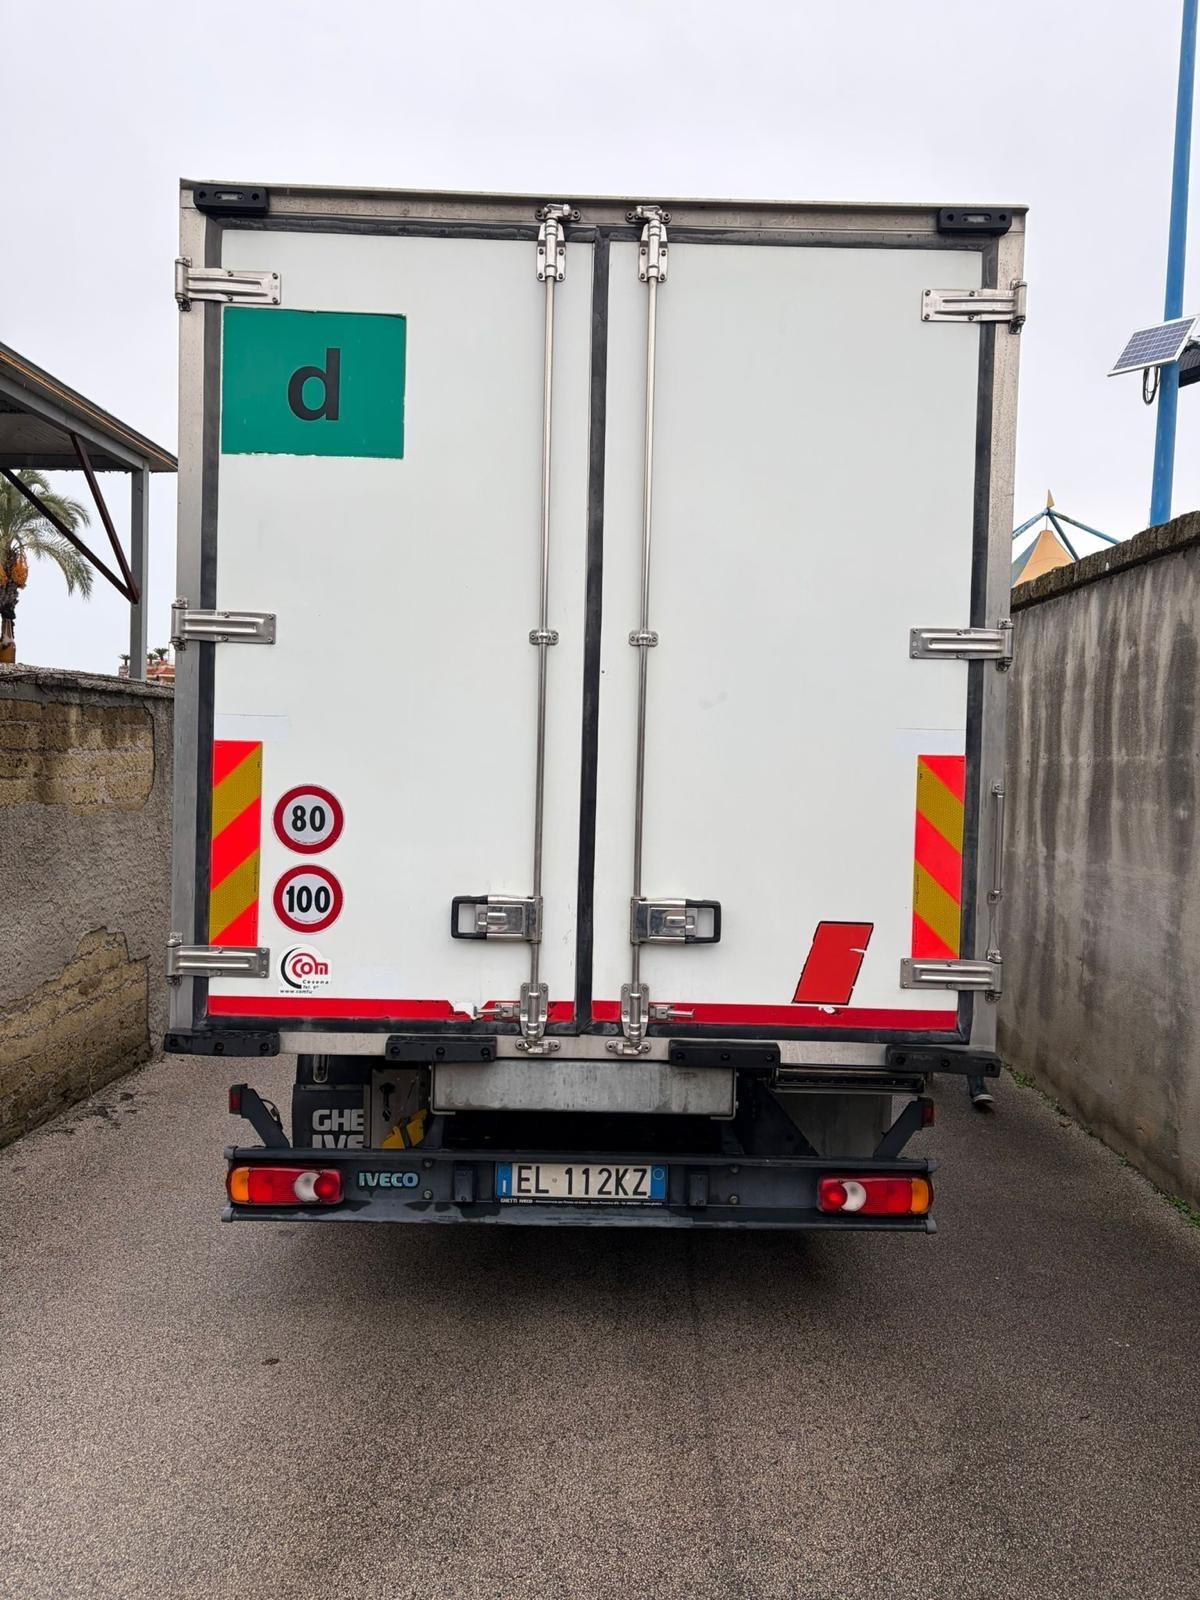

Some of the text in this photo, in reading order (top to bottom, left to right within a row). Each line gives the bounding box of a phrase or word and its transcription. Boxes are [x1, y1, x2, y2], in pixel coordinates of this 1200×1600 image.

[287, 347, 341, 421] d
[291, 804, 326, 832] 80
[286, 885, 331, 914] 100
[358, 1172, 419, 1188] IVECO
[517, 1165, 550, 1194] EL
[564, 1167, 648, 1196] 112KZ
